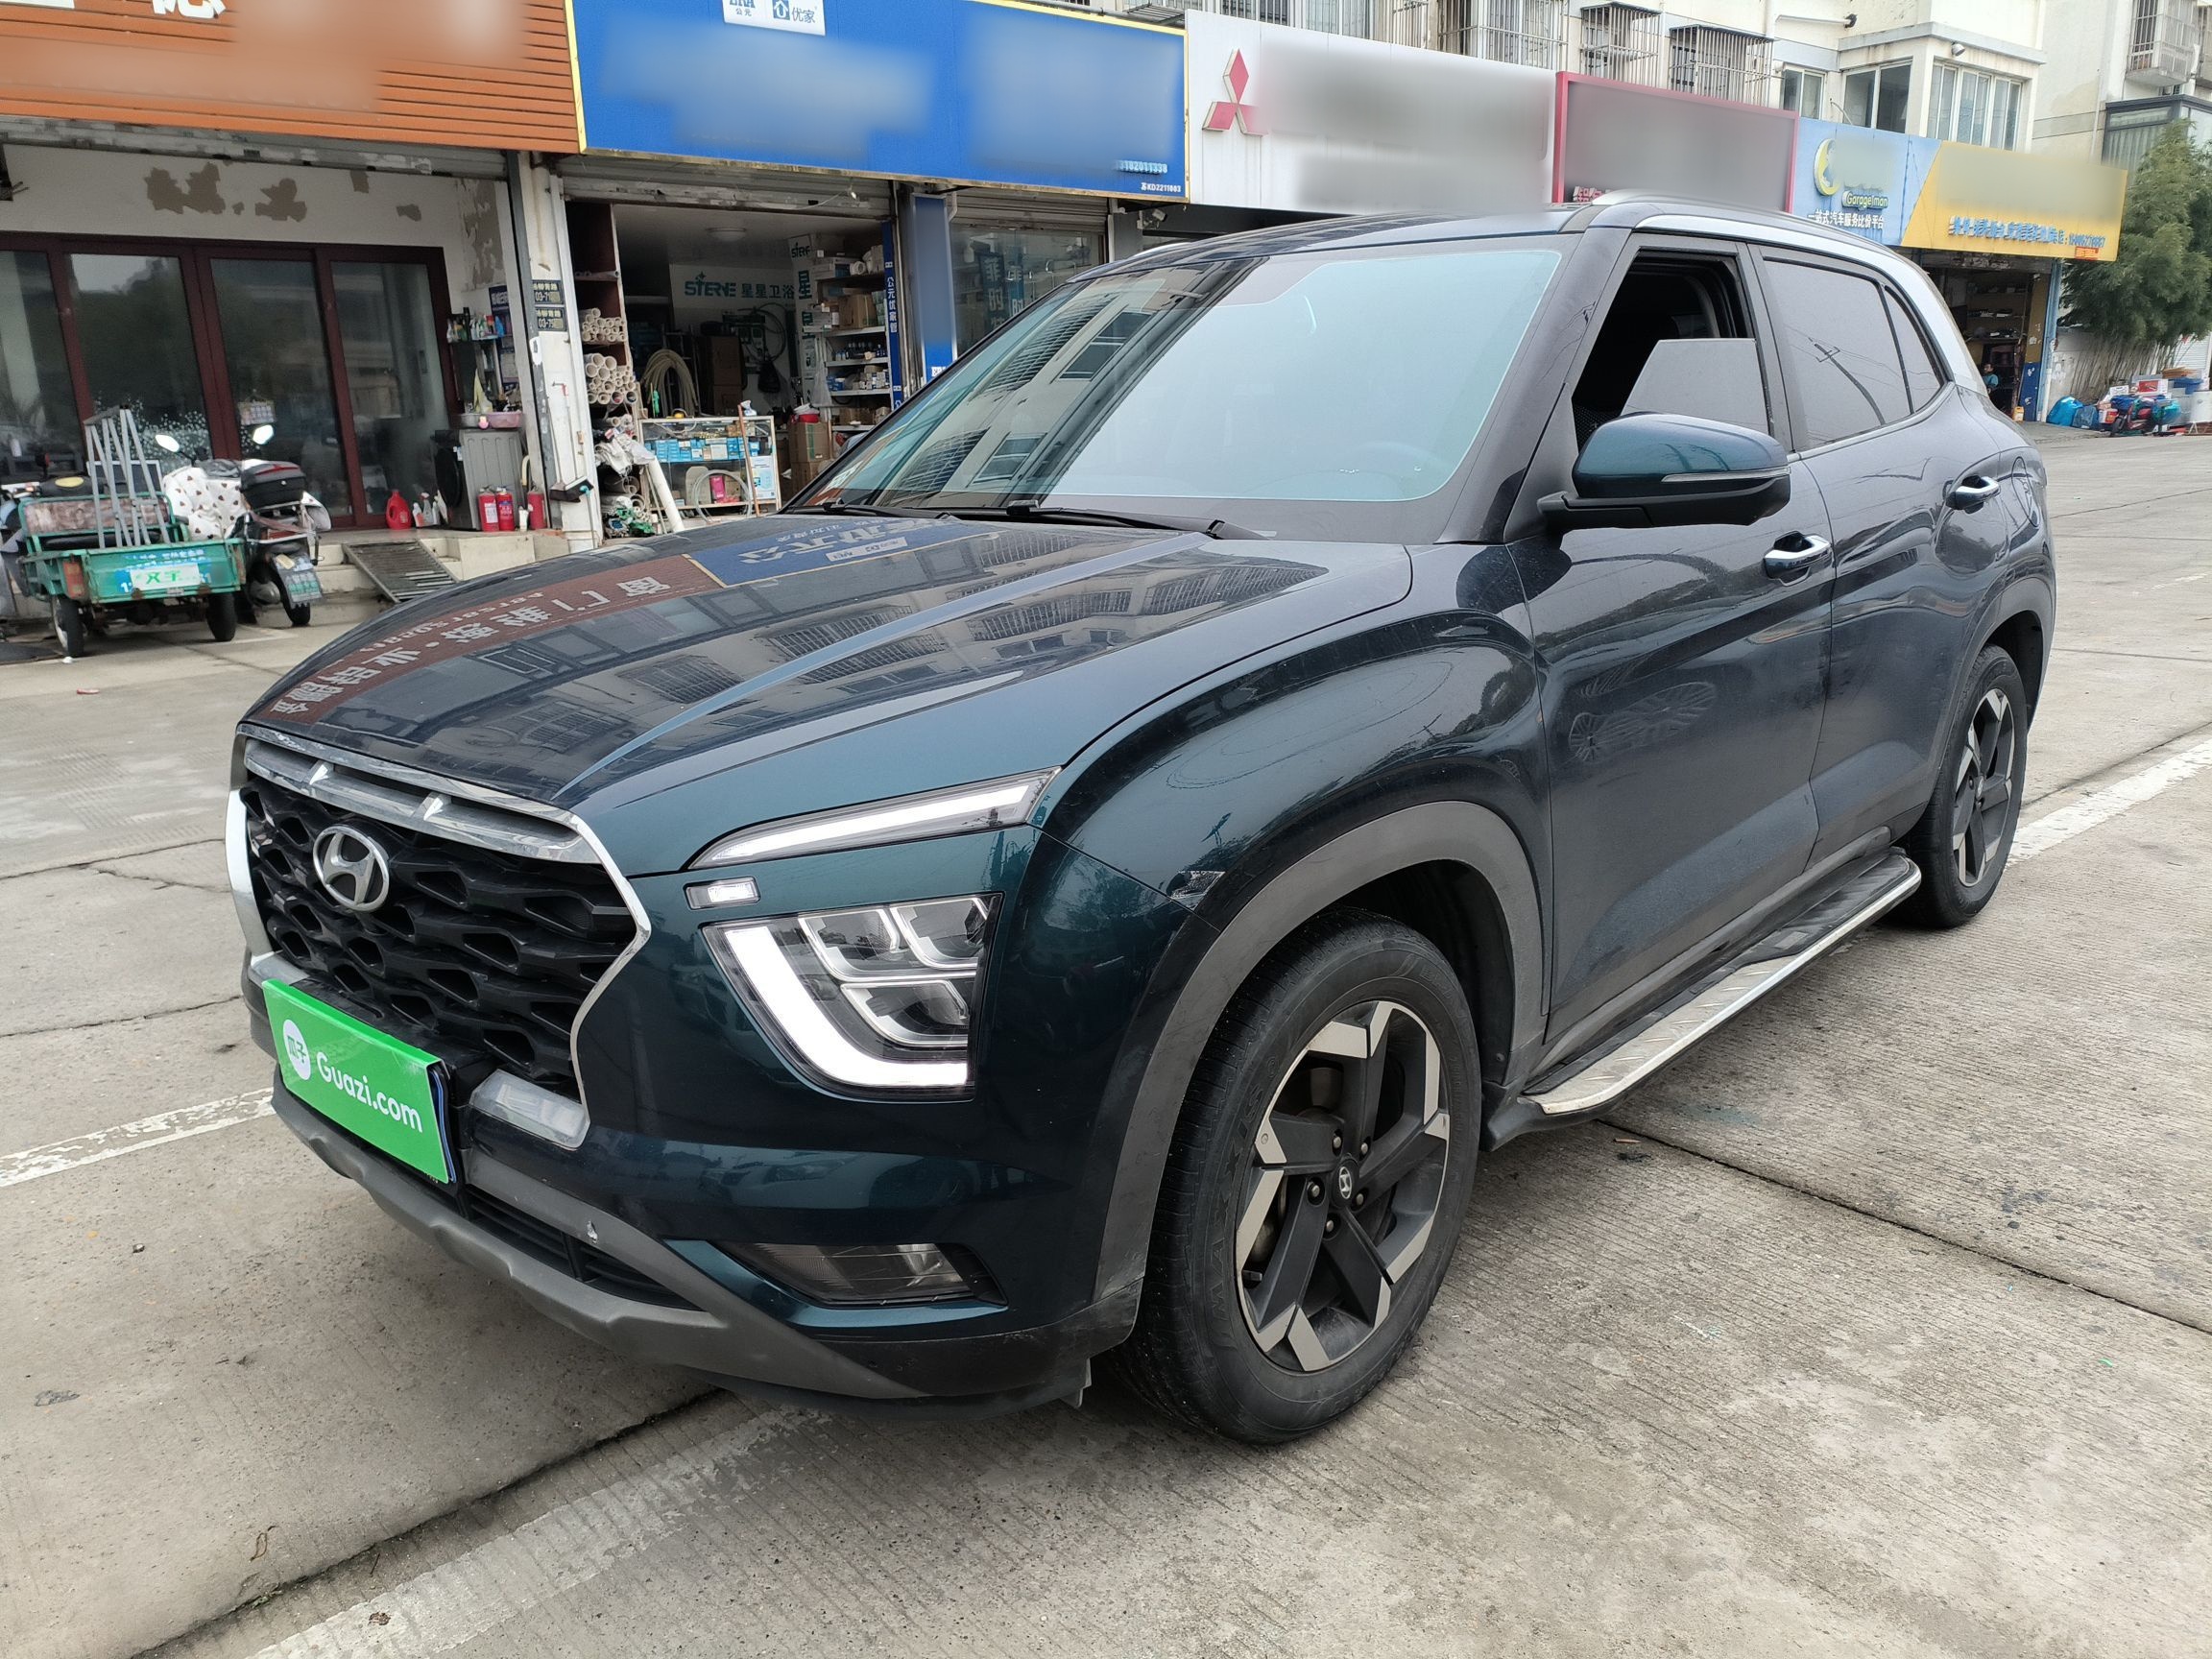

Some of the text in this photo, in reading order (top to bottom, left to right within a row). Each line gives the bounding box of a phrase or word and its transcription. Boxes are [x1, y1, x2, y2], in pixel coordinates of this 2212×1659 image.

[792, 7, 815, 23] 优家
[1808, 208, 1885, 229] 一站式汽车服务比价平台
[741, 283, 795, 300] 星星卫浴
[316, 1051, 423, 1133] Guazi.com
